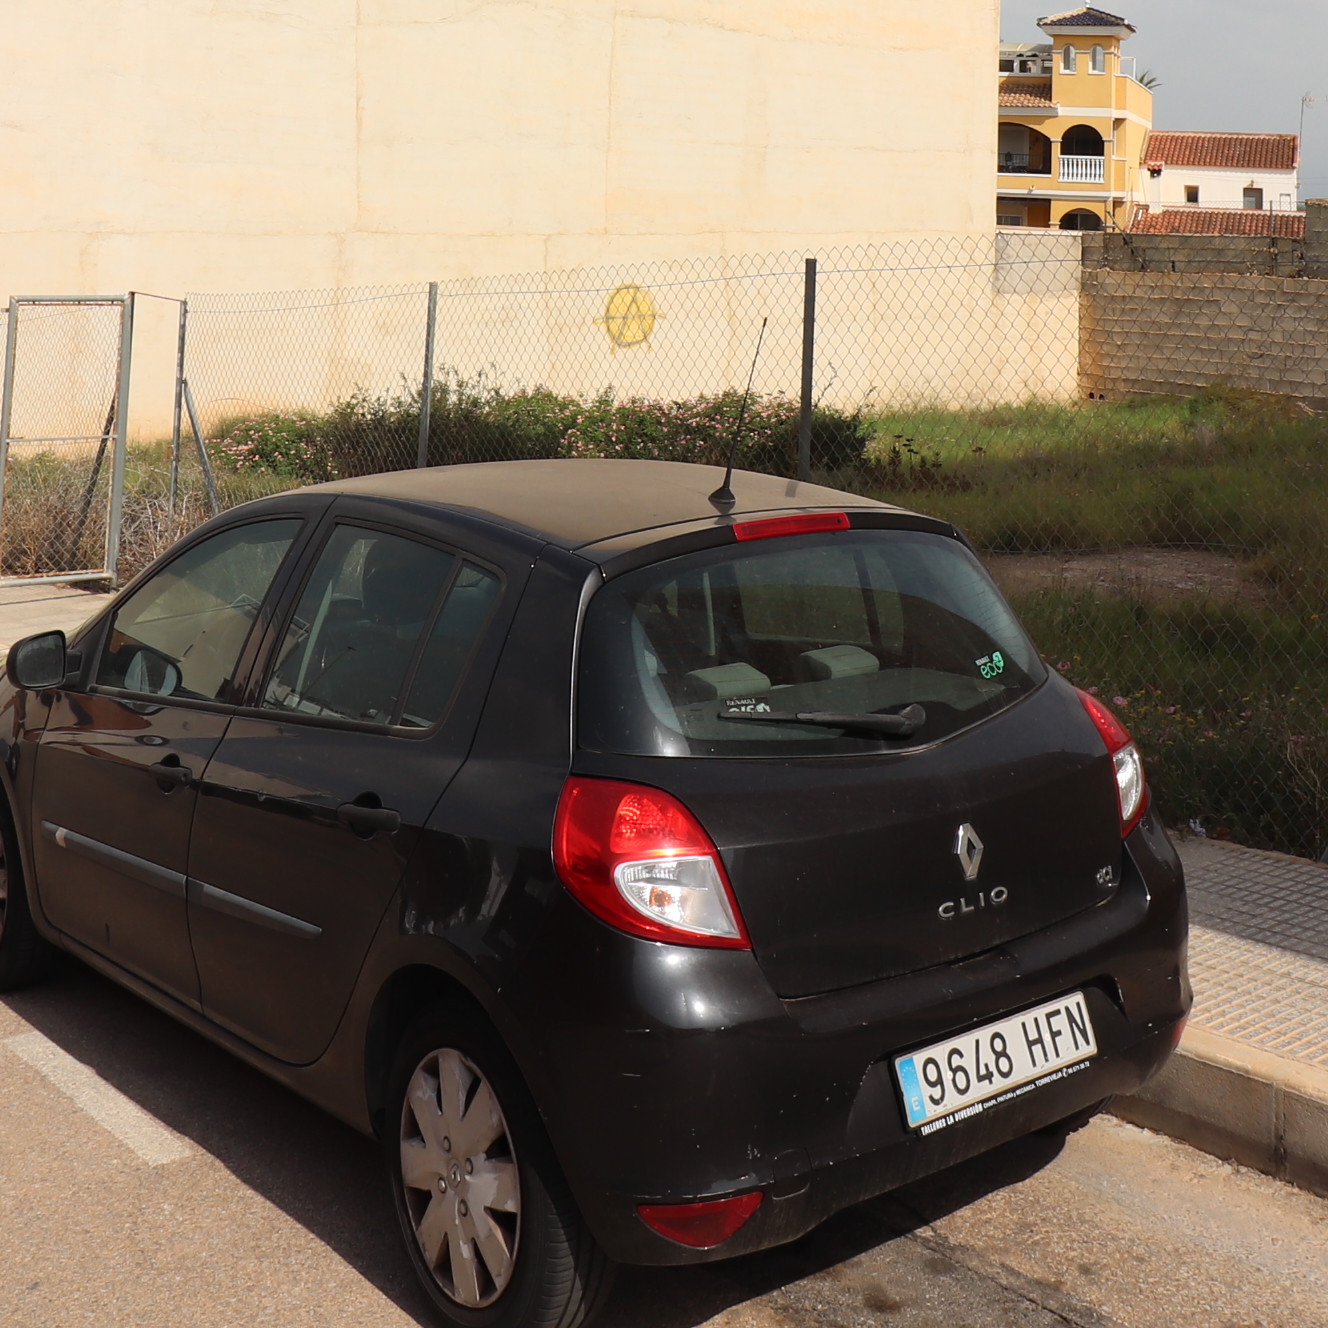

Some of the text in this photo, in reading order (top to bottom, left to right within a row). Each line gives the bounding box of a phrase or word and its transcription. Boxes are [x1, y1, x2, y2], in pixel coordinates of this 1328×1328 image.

[938, 886, 1008, 918] CLIO
[922, 1001, 1091, 1106] 9648 HFN
[911, 1096, 921, 1111] E
[921, 1118, 947, 1136] TALLERES
[946, 1115, 954, 1125] LA
[1035, 1071, 1062, 1087] TORREVIEJA
